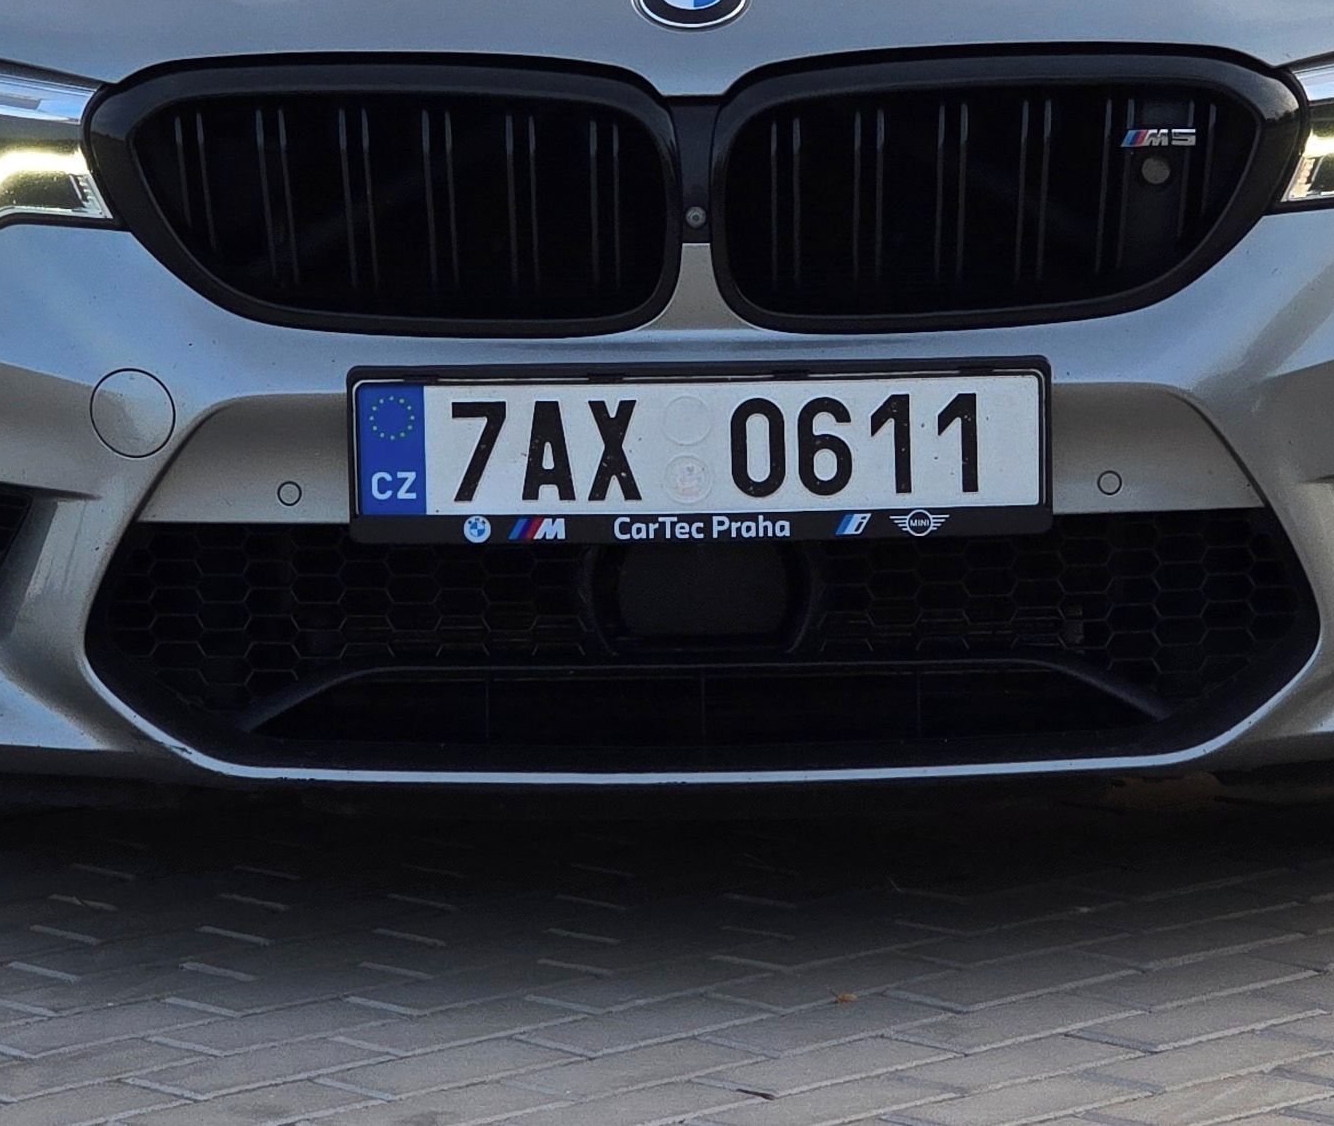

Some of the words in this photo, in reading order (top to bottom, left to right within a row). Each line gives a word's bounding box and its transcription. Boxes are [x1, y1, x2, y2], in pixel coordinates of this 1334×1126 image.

[1142, 128, 1196, 147] M5
[450, 398, 643, 503] 7AX
[729, 392, 980, 499] 0611
[370, 471, 418, 500] CZ
[613, 516, 705, 541] CarTec
[712, 514, 791, 539] Praha
[909, 518, 930, 528] MINI
